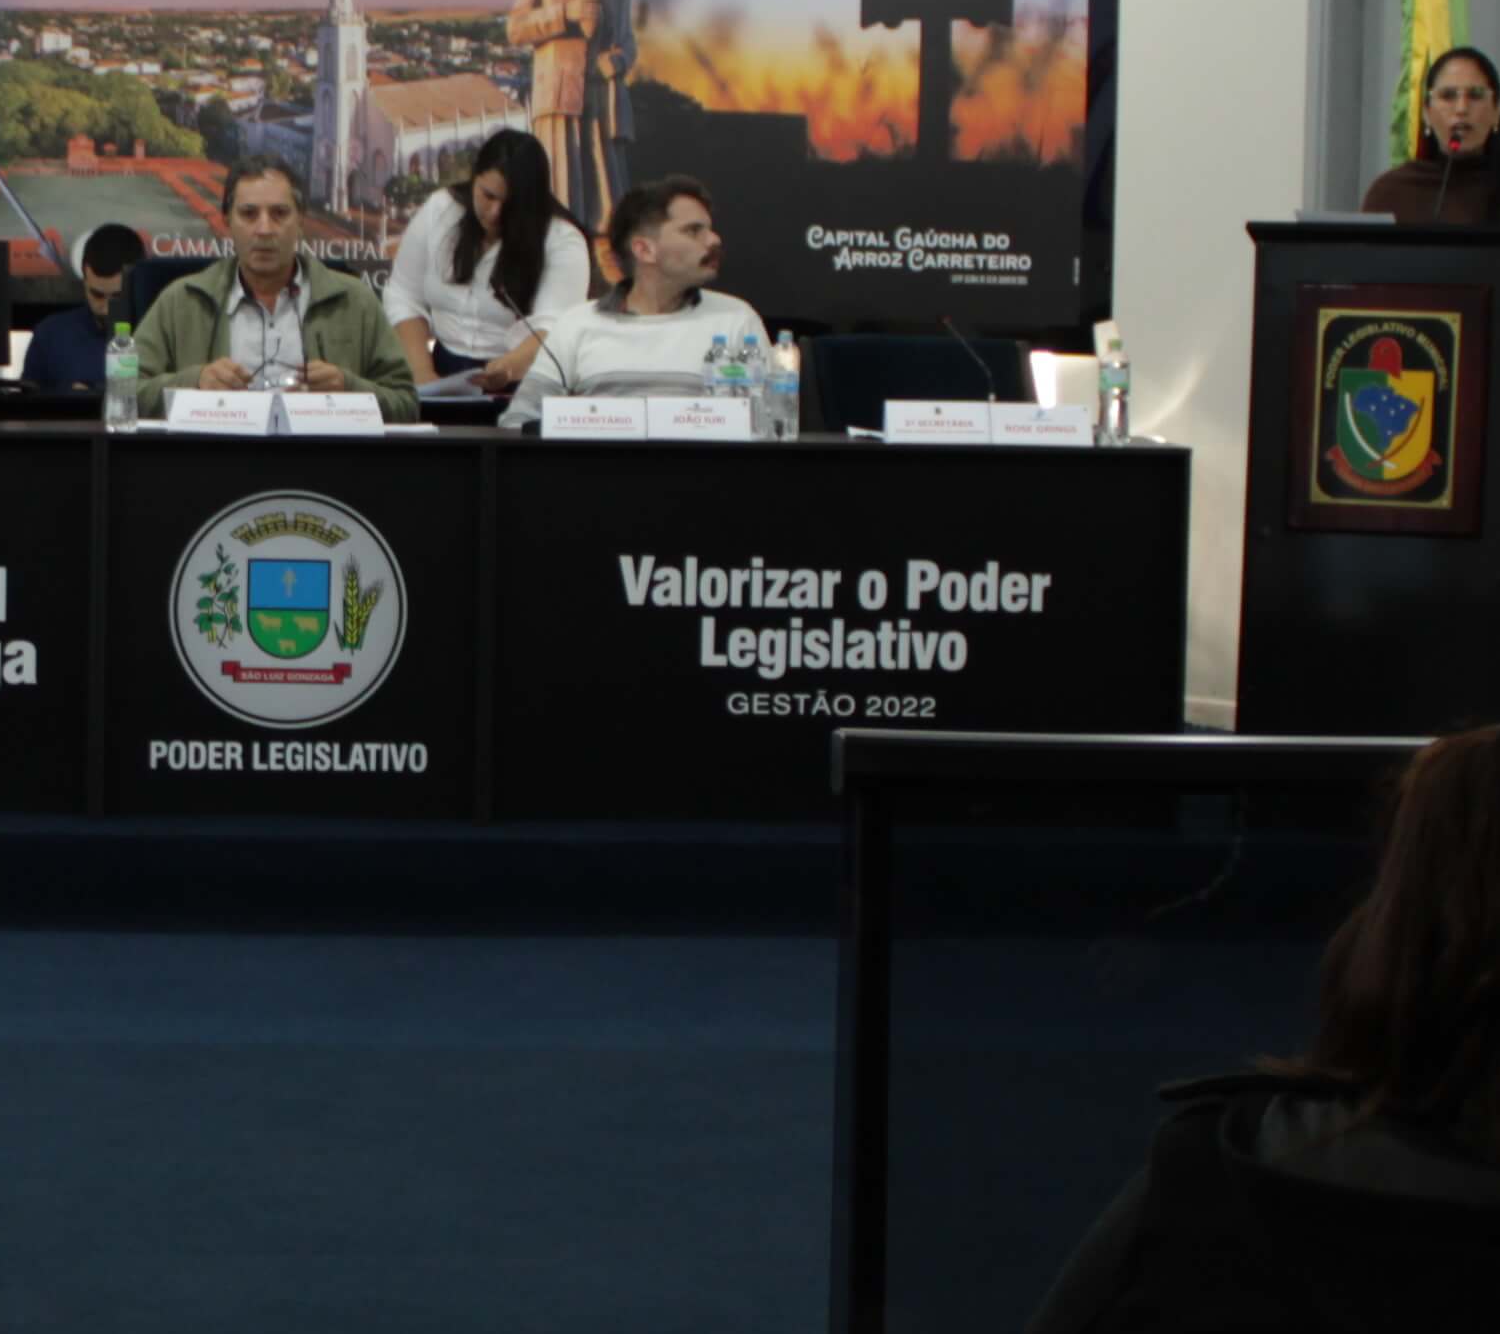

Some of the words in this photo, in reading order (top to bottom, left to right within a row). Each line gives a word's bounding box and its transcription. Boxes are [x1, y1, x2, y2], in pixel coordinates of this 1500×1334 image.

[151, 231, 236, 257] CÂMAR
[806, 225, 890, 249] CAPITAL
[895, 227, 978, 250] GAÚCHA
[983, 233, 1011, 250] DO
[833, 247, 904, 272] ARROZ
[908, 249, 1032, 271] CARRETEIRO
[617, 555, 842, 609] Valorizar
[858, 570, 889, 611] o
[905, 560, 1052, 613] Poder
[700, 616, 969, 679] Legislativo
[726, 690, 857, 718] GESTÃO
[865, 696, 938, 719] 2022
[149, 741, 244, 770] PODER
[252, 742, 429, 772] LEGISLATIVO
